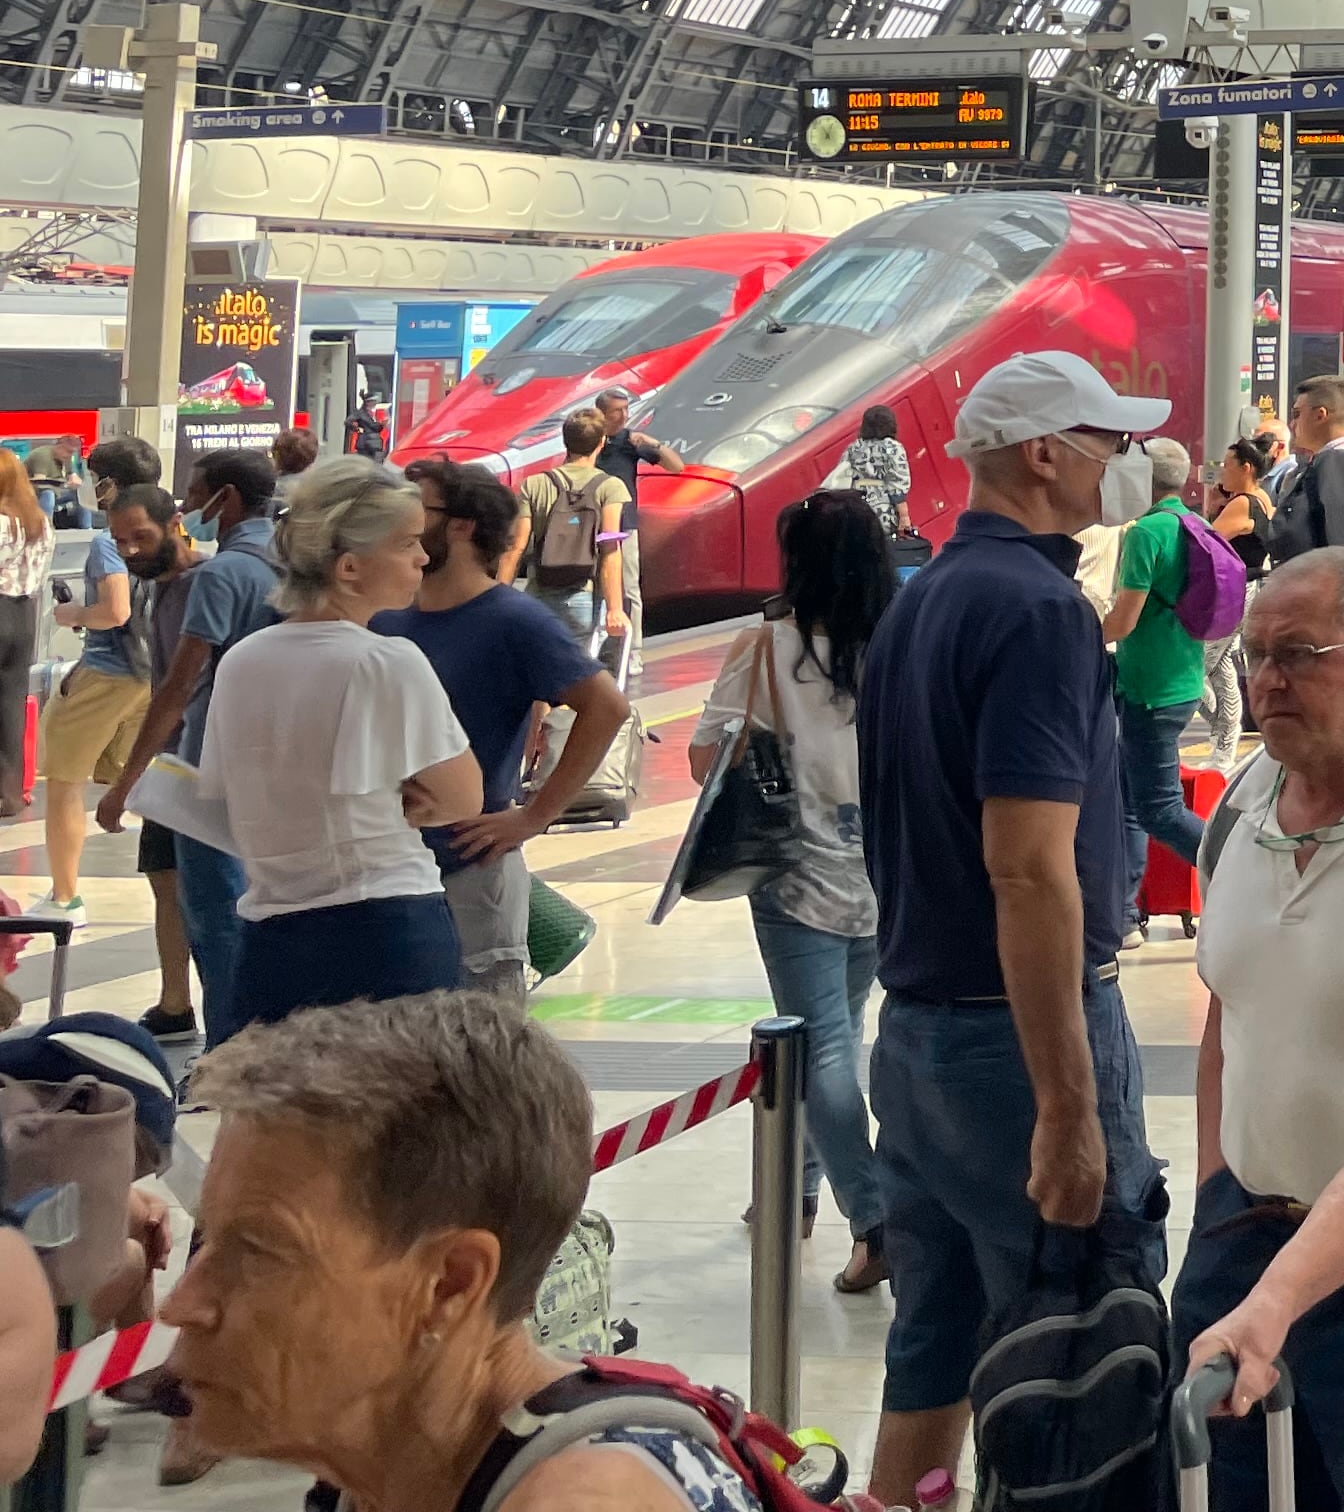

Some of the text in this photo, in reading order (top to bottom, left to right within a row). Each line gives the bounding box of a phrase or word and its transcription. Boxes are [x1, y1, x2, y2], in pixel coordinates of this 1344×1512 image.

[811, 88, 830, 108] 14
[849, 91, 939, 108] ROMA TERMINI
[1168, 84, 1292, 106] Zona fumatori
[193, 112, 302, 129] Smoking area
[848, 115, 879, 130] 11:15
[196, 315, 281, 351] is magic
[185, 422, 281, 437] TRA MILANO E VENEZIA
[203, 437, 227, 448] TRENI
[228, 437, 240, 447] AL
[240, 436, 273, 448] GIORNO
